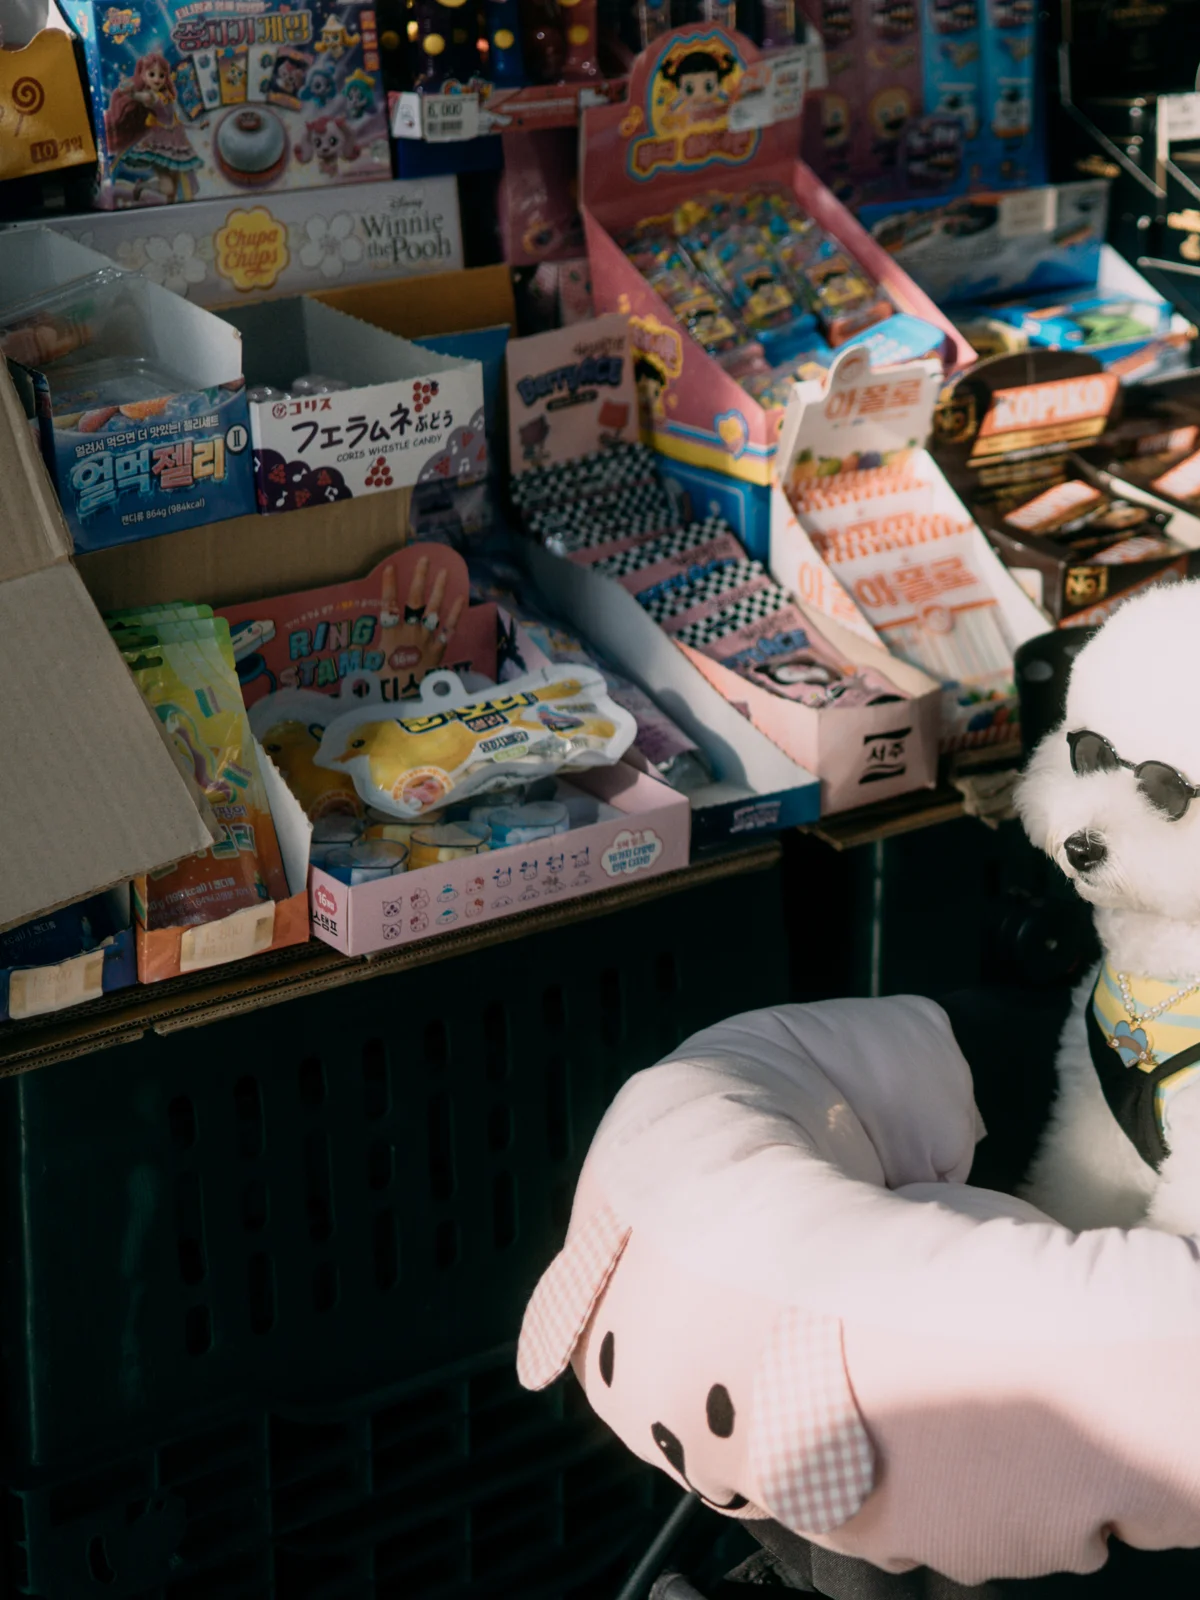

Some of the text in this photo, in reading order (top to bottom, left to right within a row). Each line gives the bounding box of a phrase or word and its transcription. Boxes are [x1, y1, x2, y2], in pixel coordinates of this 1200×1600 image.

[224, 226, 279, 251] Chupa
[360, 209, 444, 237] Winnie
[224, 248, 279, 277] Chups
[368, 232, 452, 263] the Pooh
[289, 397, 332, 416] コリス
[823, 378, 922, 420] 아폴로
[993, 379, 1106, 428] KOPIKO
[74, 441, 105, 458] 얼려서
[106, 432, 137, 448] 먹으면
[137, 428, 148, 440] 더
[183, 414, 220, 431] 젤리세트
[291, 403, 454, 454] フェラムネ ぶどう
[336, 434, 444, 463] CORIS WHISTLE CANDY
[71, 437, 228, 512] 얼먹젤리
[145, 508, 168, 521] 864g
[854, 556, 978, 607] 아폴로
[288, 615, 378, 661] RING
[279, 646, 385, 689] STAMP
